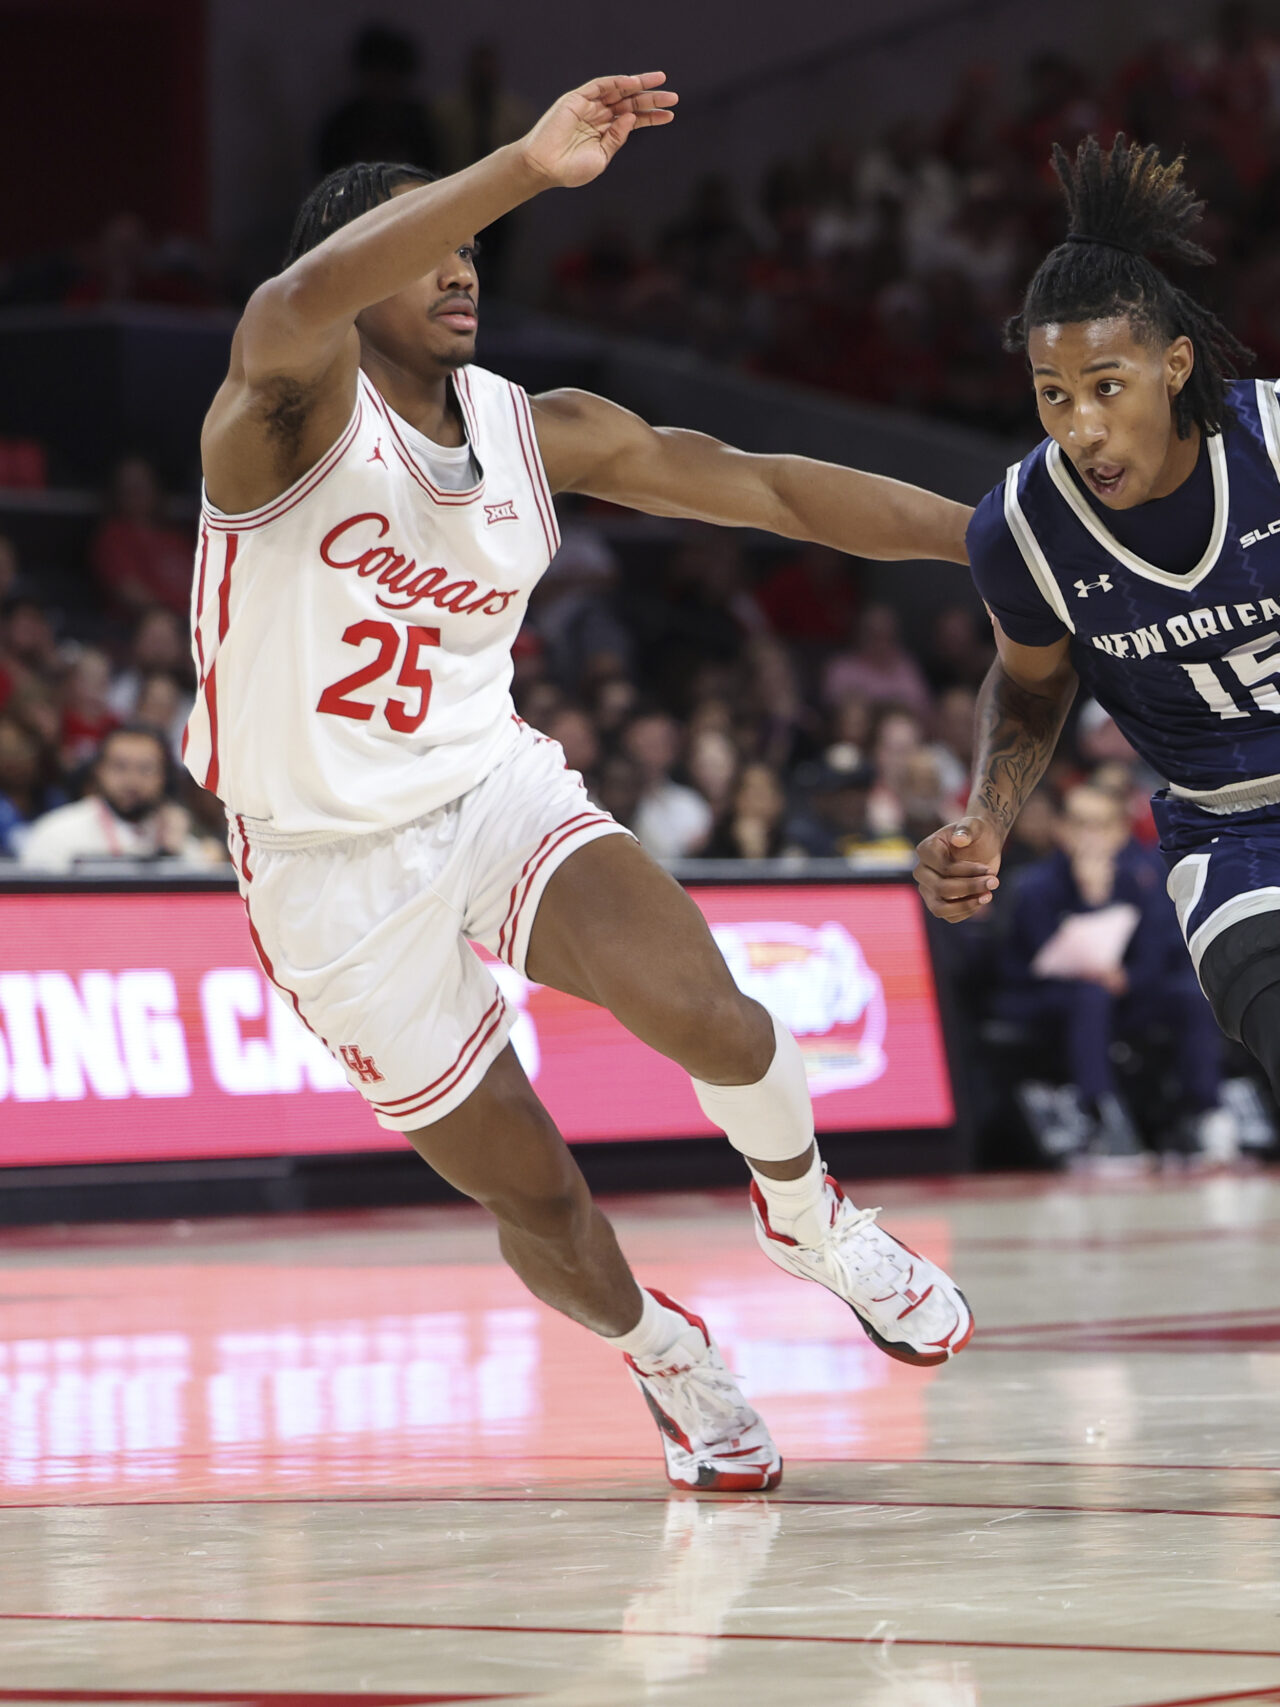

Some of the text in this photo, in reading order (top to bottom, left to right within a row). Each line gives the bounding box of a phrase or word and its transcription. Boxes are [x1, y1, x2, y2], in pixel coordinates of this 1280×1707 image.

[320, 512, 519, 615] Cougars
[316, 619, 441, 734] 25
[1092, 624, 1167, 659] NEW
[339, 1044, 385, 1084] UH
